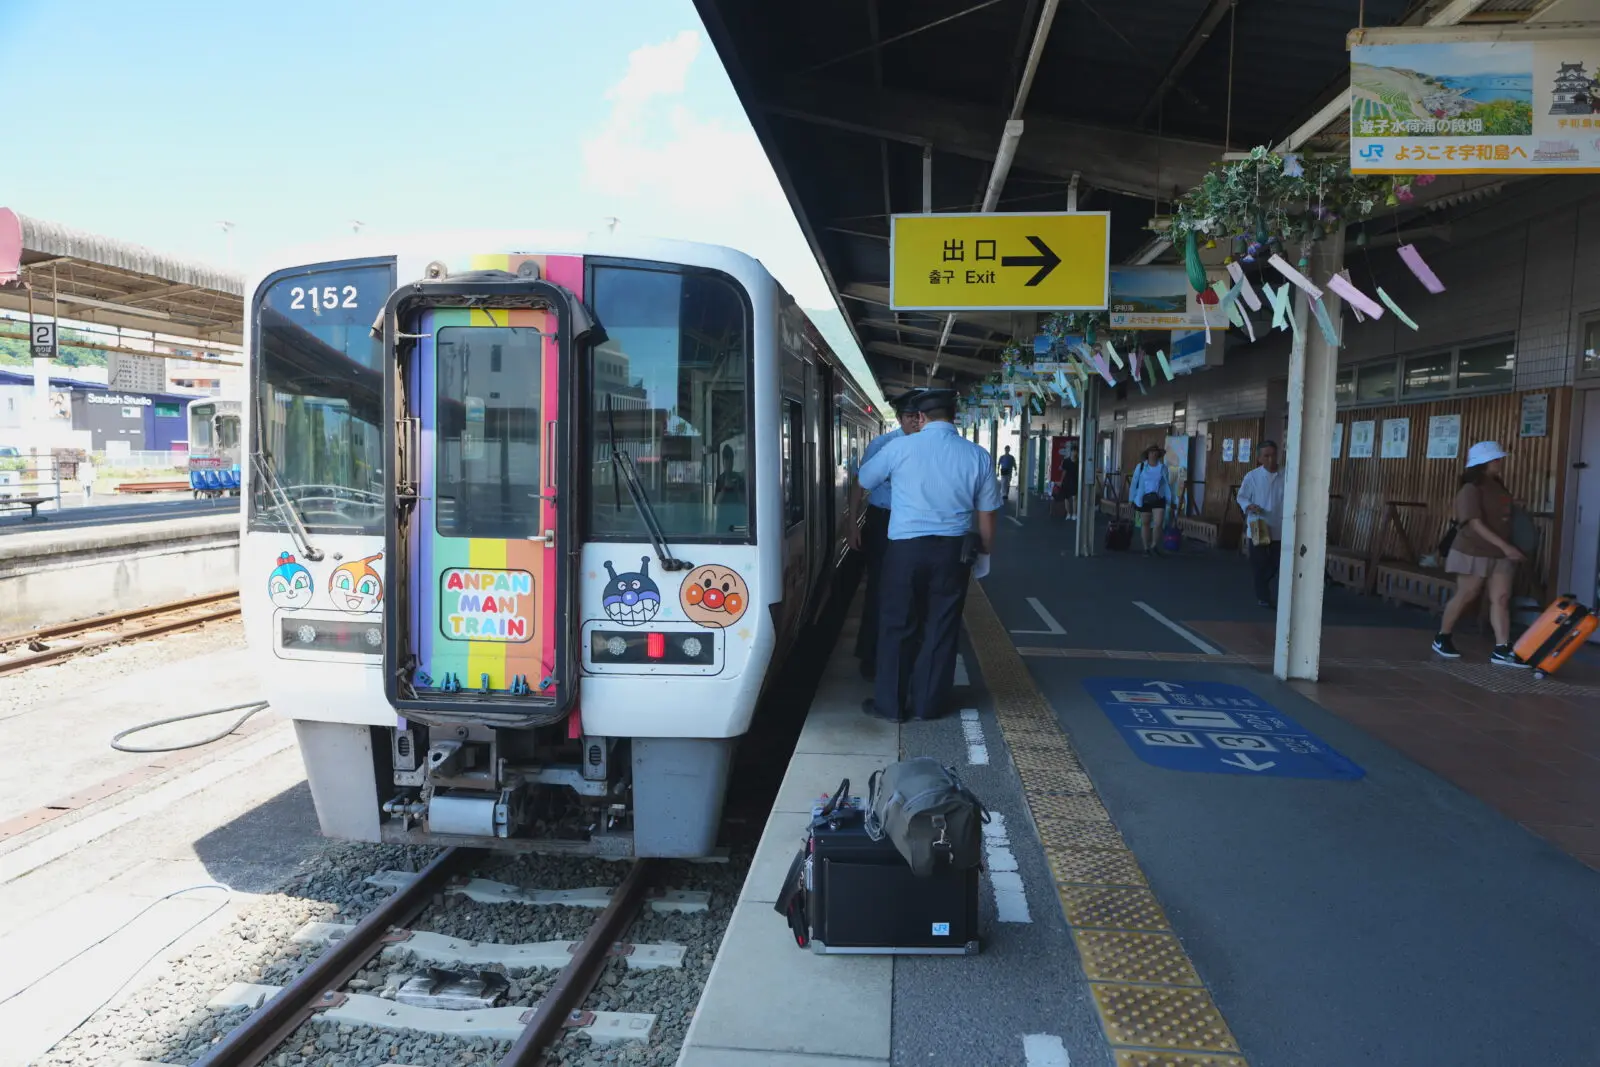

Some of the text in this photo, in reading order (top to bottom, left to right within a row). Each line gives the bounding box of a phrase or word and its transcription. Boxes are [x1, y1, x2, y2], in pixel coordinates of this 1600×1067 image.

[1359, 118, 1483, 134] 遊子水荷浦の段畑
[1359, 144, 1385, 158] JR
[1394, 144, 1528, 161] ようこそ宇和島へ
[942, 238, 997, 263] 出口
[929, 269, 955, 285] 출구
[965, 270, 996, 285] Exit
[290, 286, 358, 310] 2152
[36, 326, 49, 343] 2
[123, 394, 152, 406] Studio
[447, 571, 530, 594] ANPAN
[460, 594, 515, 614] MAN
[450, 615, 525, 637] TRAIN
[1145, 732, 1267, 749] 2 3
